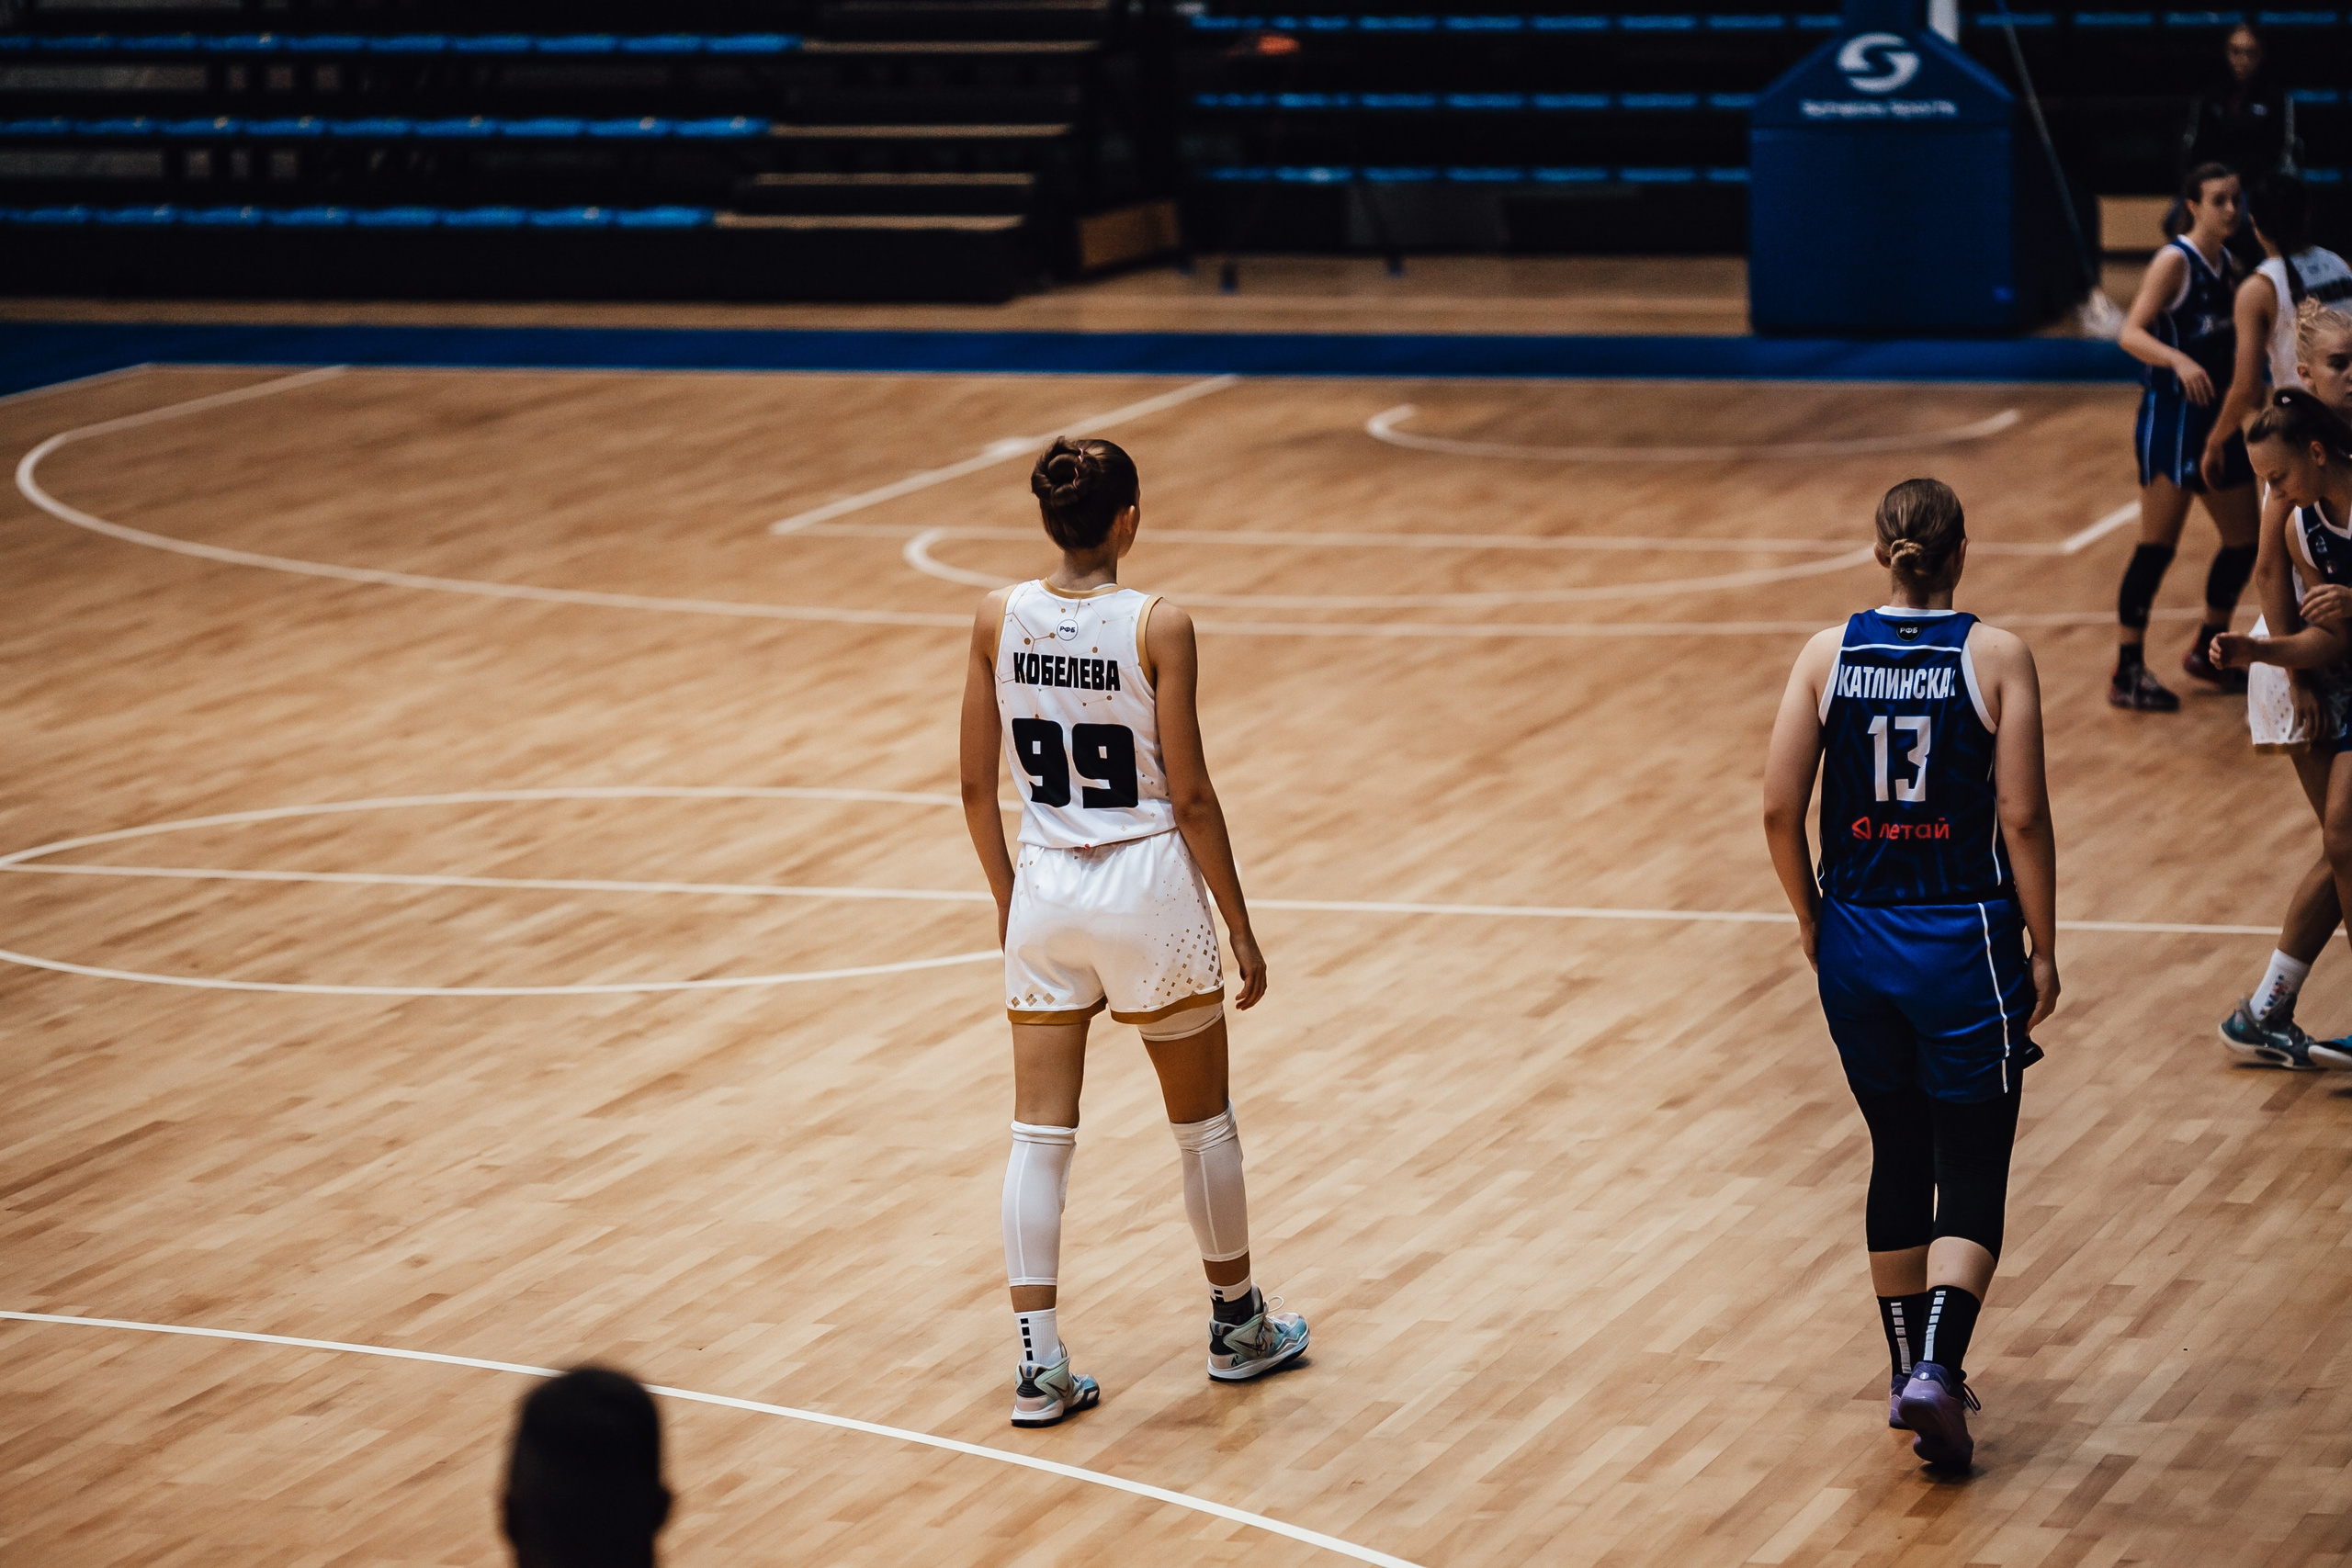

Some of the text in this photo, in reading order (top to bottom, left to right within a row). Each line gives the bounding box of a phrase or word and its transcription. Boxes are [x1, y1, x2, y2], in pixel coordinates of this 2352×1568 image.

[1013, 652, 1121, 691] КОБЕЛЕВА
[1012, 717, 1139, 809] 99
[1867, 716, 1931, 802] 13
